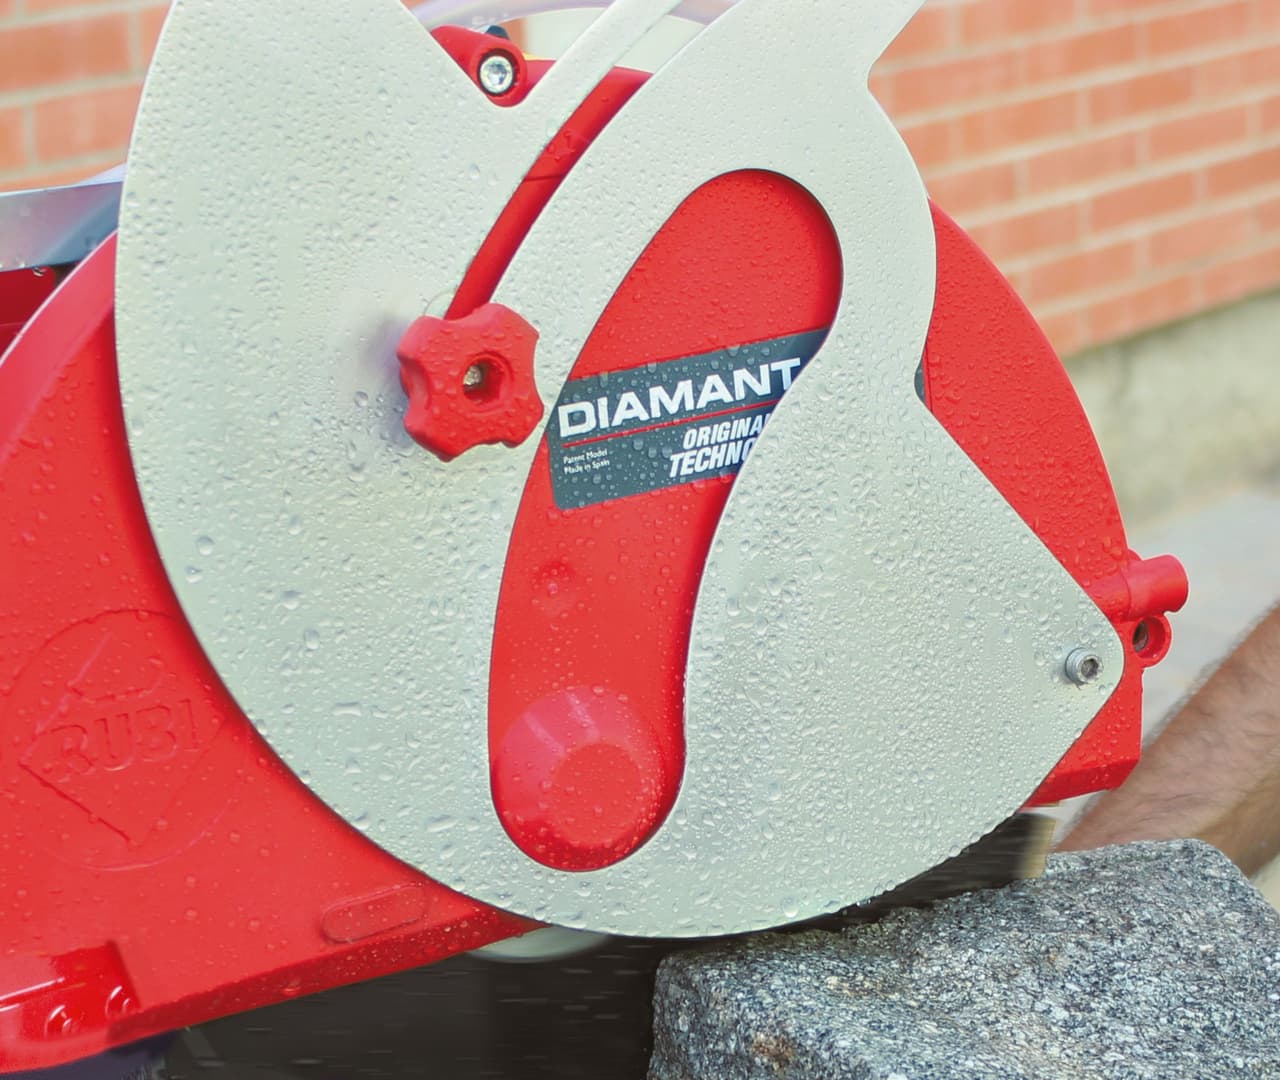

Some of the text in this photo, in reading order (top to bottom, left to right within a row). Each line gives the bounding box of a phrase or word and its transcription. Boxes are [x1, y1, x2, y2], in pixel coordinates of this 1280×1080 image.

[558, 357, 801, 438] DIAMANT
[669, 437, 757, 478] TECHNO
[682, 413, 770, 450] ORIGINA
[48, 698, 202, 782] RUBI
